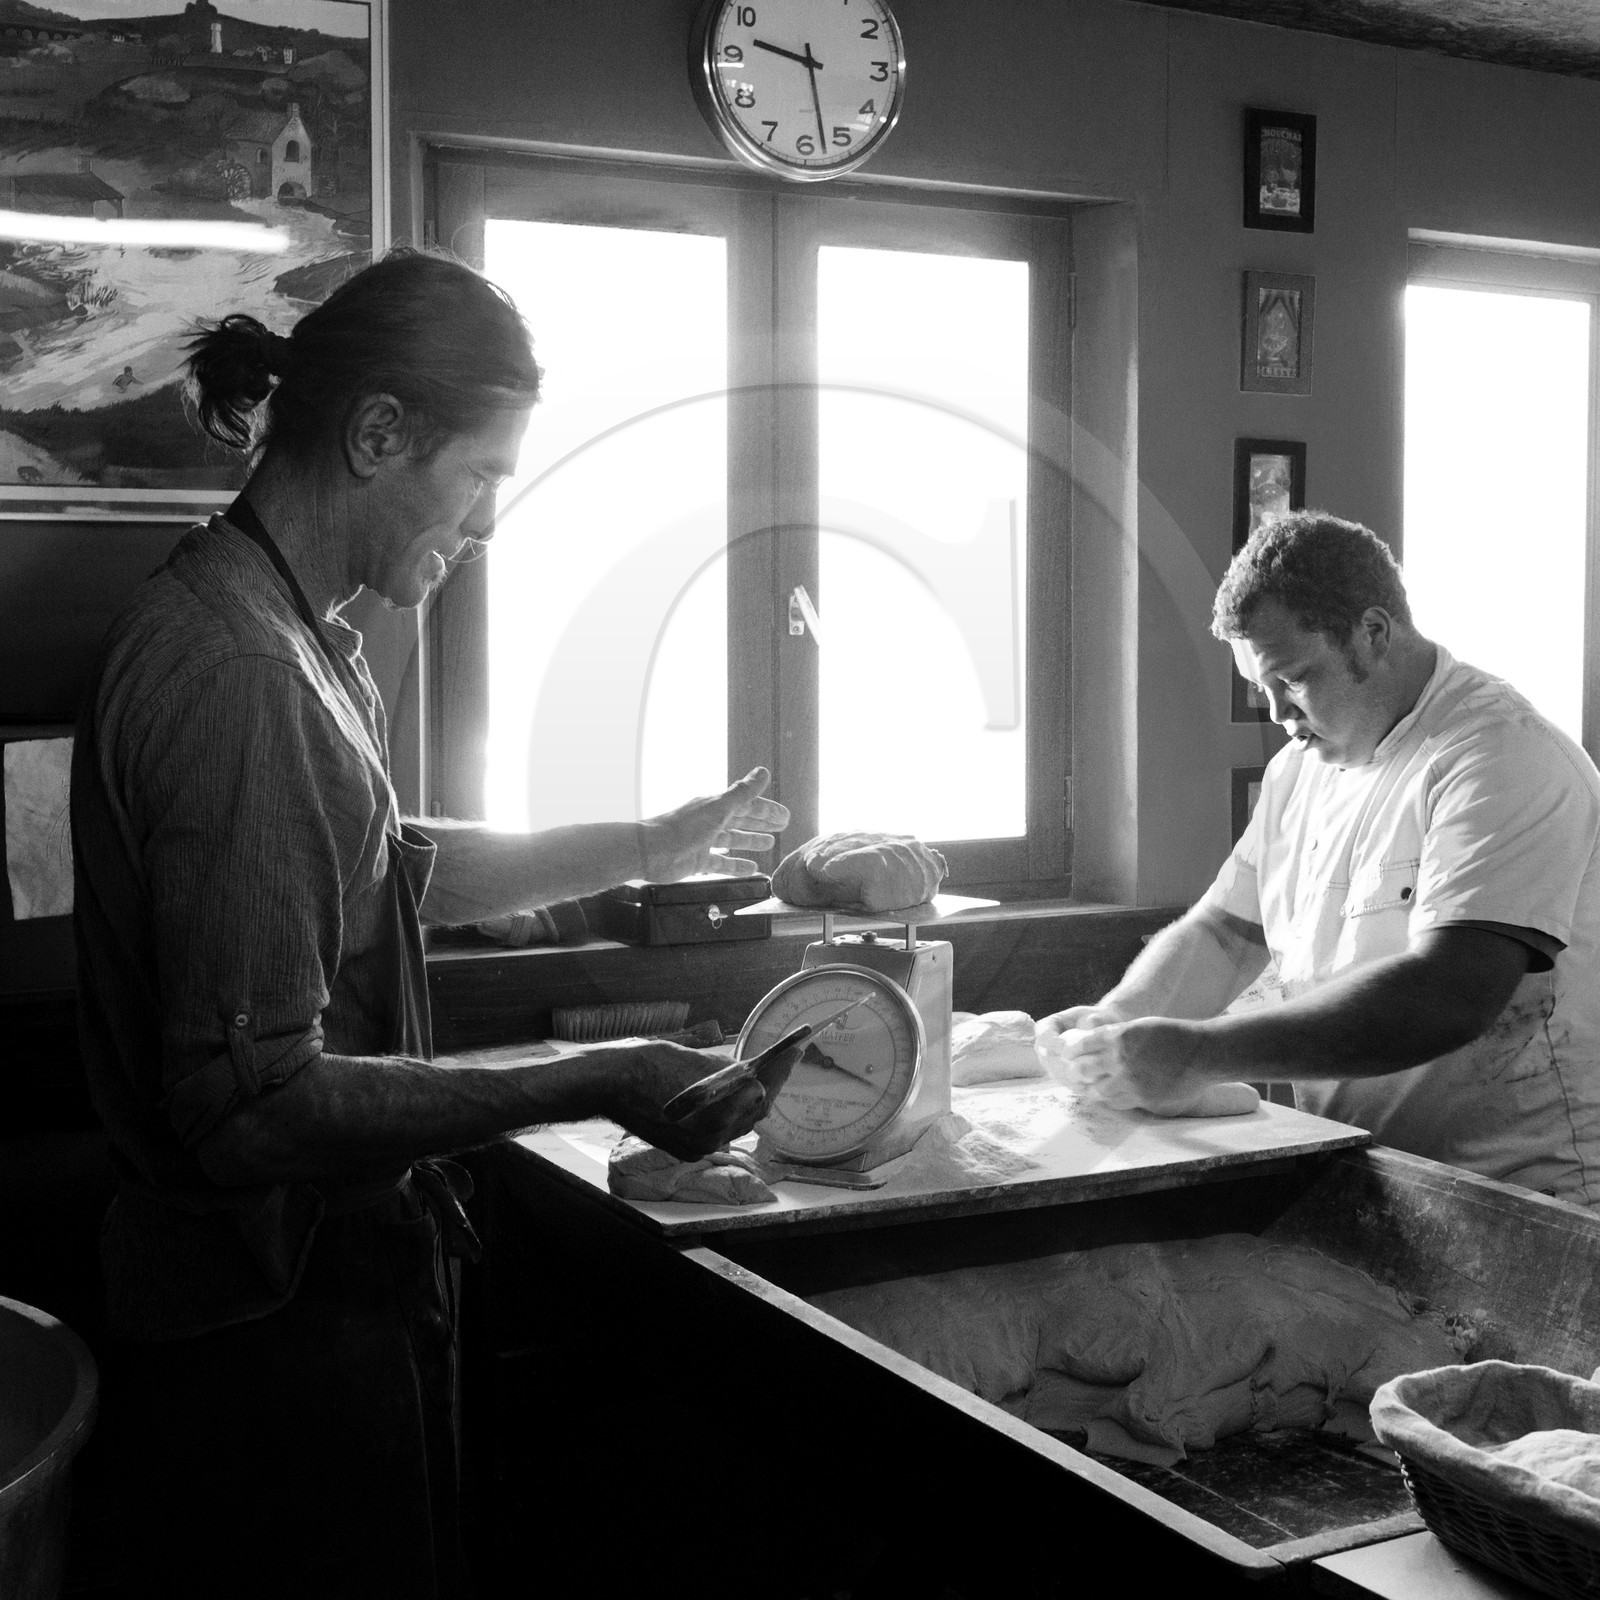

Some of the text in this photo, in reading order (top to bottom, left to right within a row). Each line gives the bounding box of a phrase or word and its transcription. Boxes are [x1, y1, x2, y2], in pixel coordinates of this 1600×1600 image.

[737, 6, 756, 27] 10
[860, 19, 879, 40] 2
[723, 45, 743, 63] 9
[869, 61, 889, 82] 3
[735, 88, 756, 108] 8
[858, 99, 876, 119] 4
[762, 120, 778, 141] 7
[832, 127, 852, 147] 5
[796, 135, 815, 156] 6
